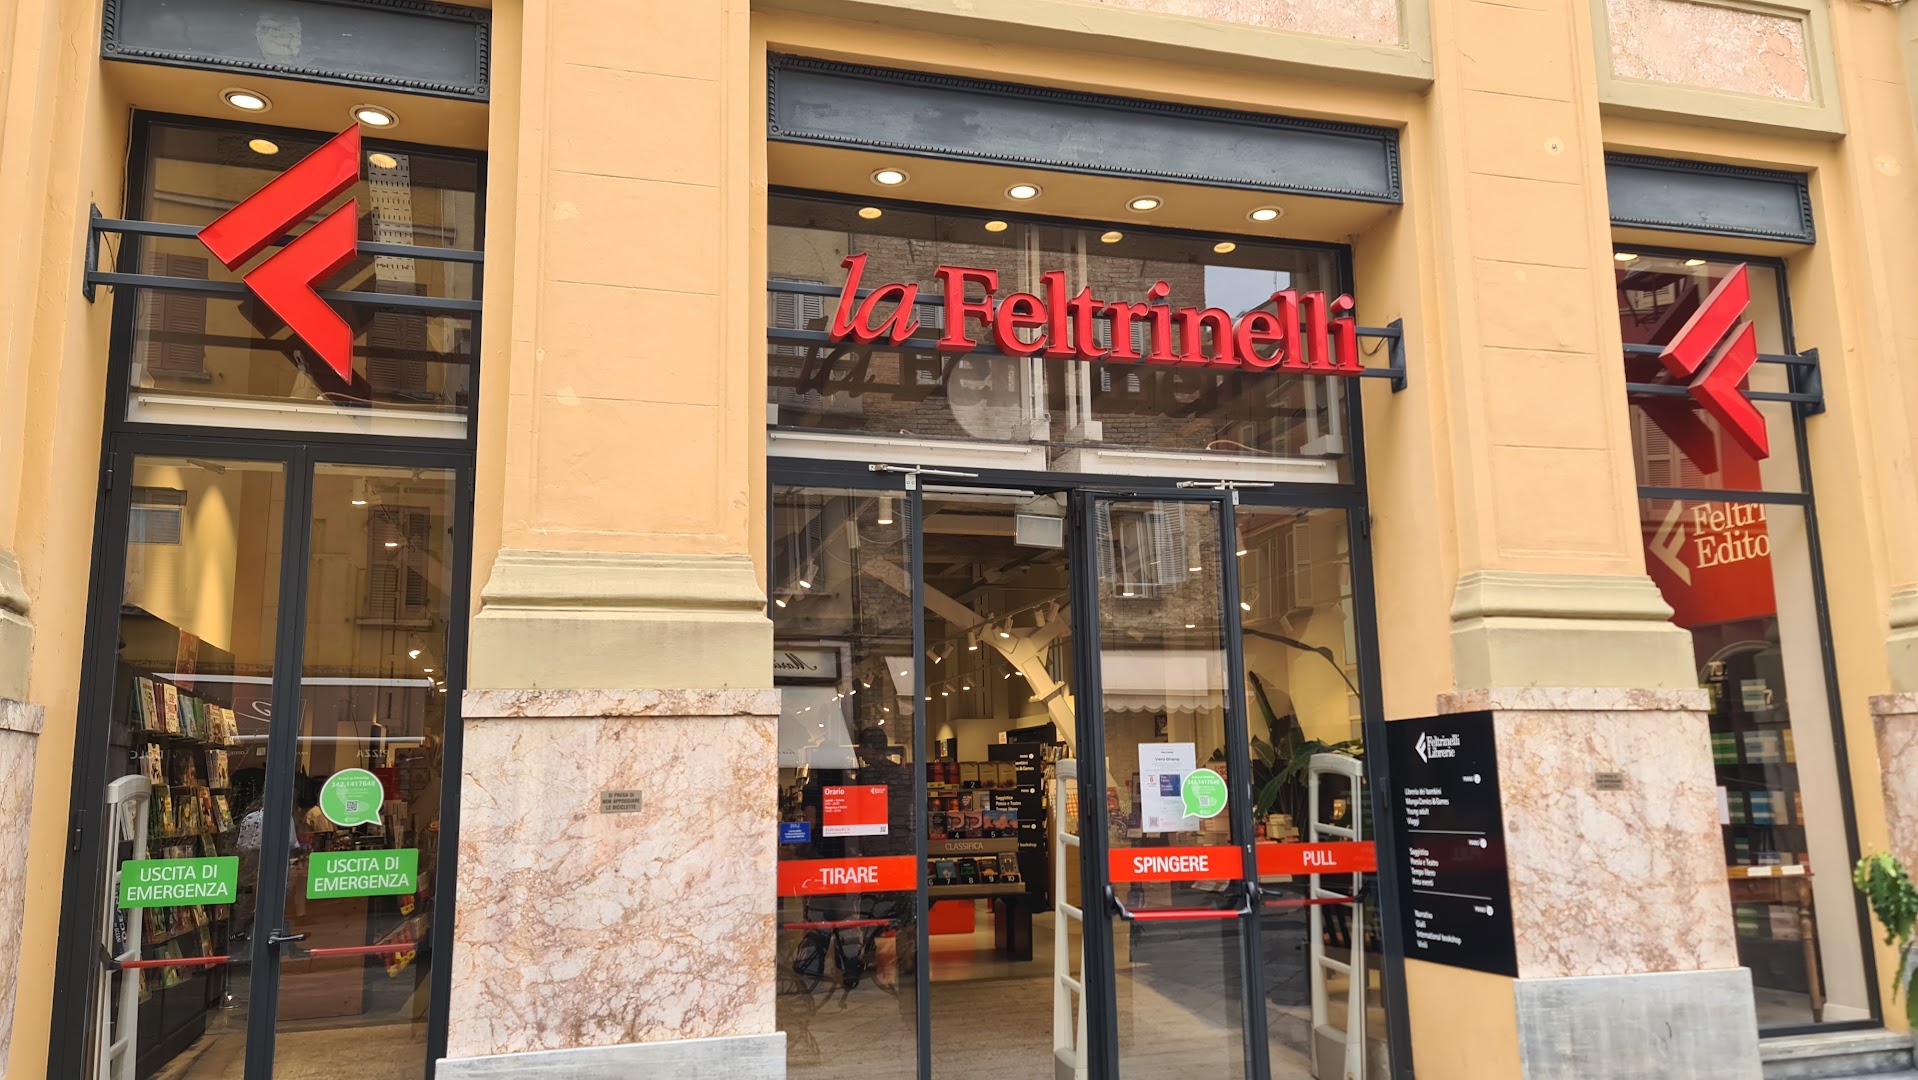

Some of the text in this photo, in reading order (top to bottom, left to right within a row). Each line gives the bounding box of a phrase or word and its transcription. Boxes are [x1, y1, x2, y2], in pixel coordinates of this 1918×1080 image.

[828, 251, 1366, 376] la Feltrinelli
[1694, 530, 1771, 568] Edito
[1426, 733, 1460, 747] Feltrinelli
[1427, 746, 1456, 758] Librerie
[945, 842, 984, 851] CLASSIFICA
[326, 856, 400, 874] USCITA DI
[1133, 855, 1209, 873] SPINGERE
[1303, 850, 1337, 867] PULL
[139, 864, 218, 882] USCITA DI
[819, 866, 878, 886] TIRARE
[127, 882, 229, 901] EMERGENZA
[314, 873, 410, 892] EMERGENZA
